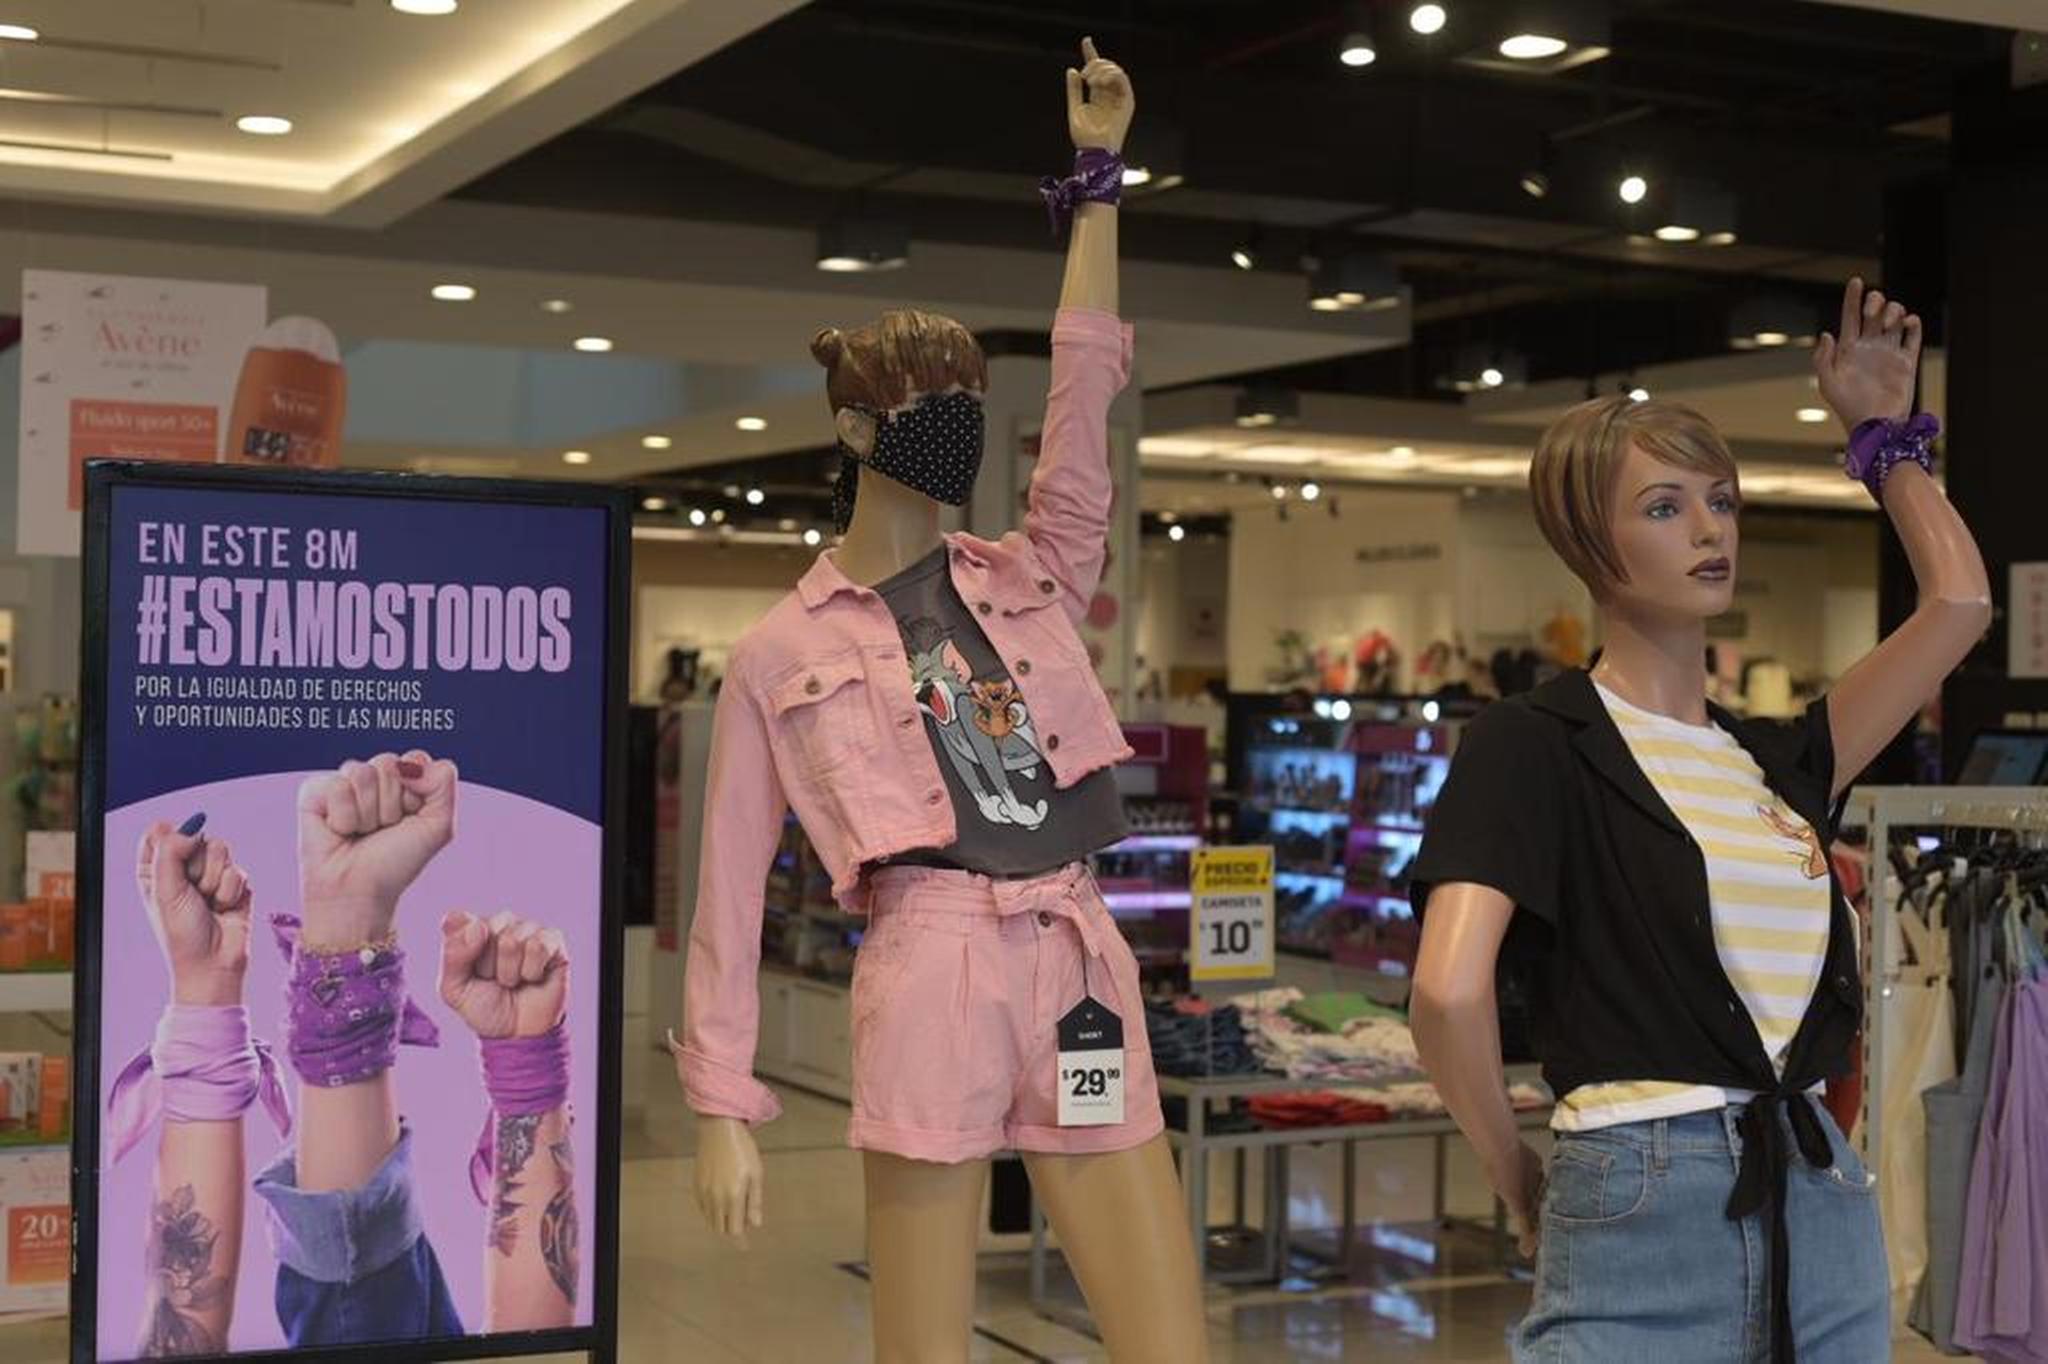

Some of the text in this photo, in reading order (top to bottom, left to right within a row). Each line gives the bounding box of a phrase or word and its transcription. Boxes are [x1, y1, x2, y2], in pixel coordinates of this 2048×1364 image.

[97, 319, 201, 356] Avène
[139, 522, 357, 571] EN ESTE 8M
[136, 575, 571, 673] #ESTAMOSTODOS
[135, 676, 422, 702] POR LA IGUALDAD DE DERECHOS
[135, 705, 455, 730] Y OPORTUNIDADES DE LAS MUJERES
[1204, 862, 1259, 874] PRECIO
[1202, 896, 1262, 908] CAMISETA
